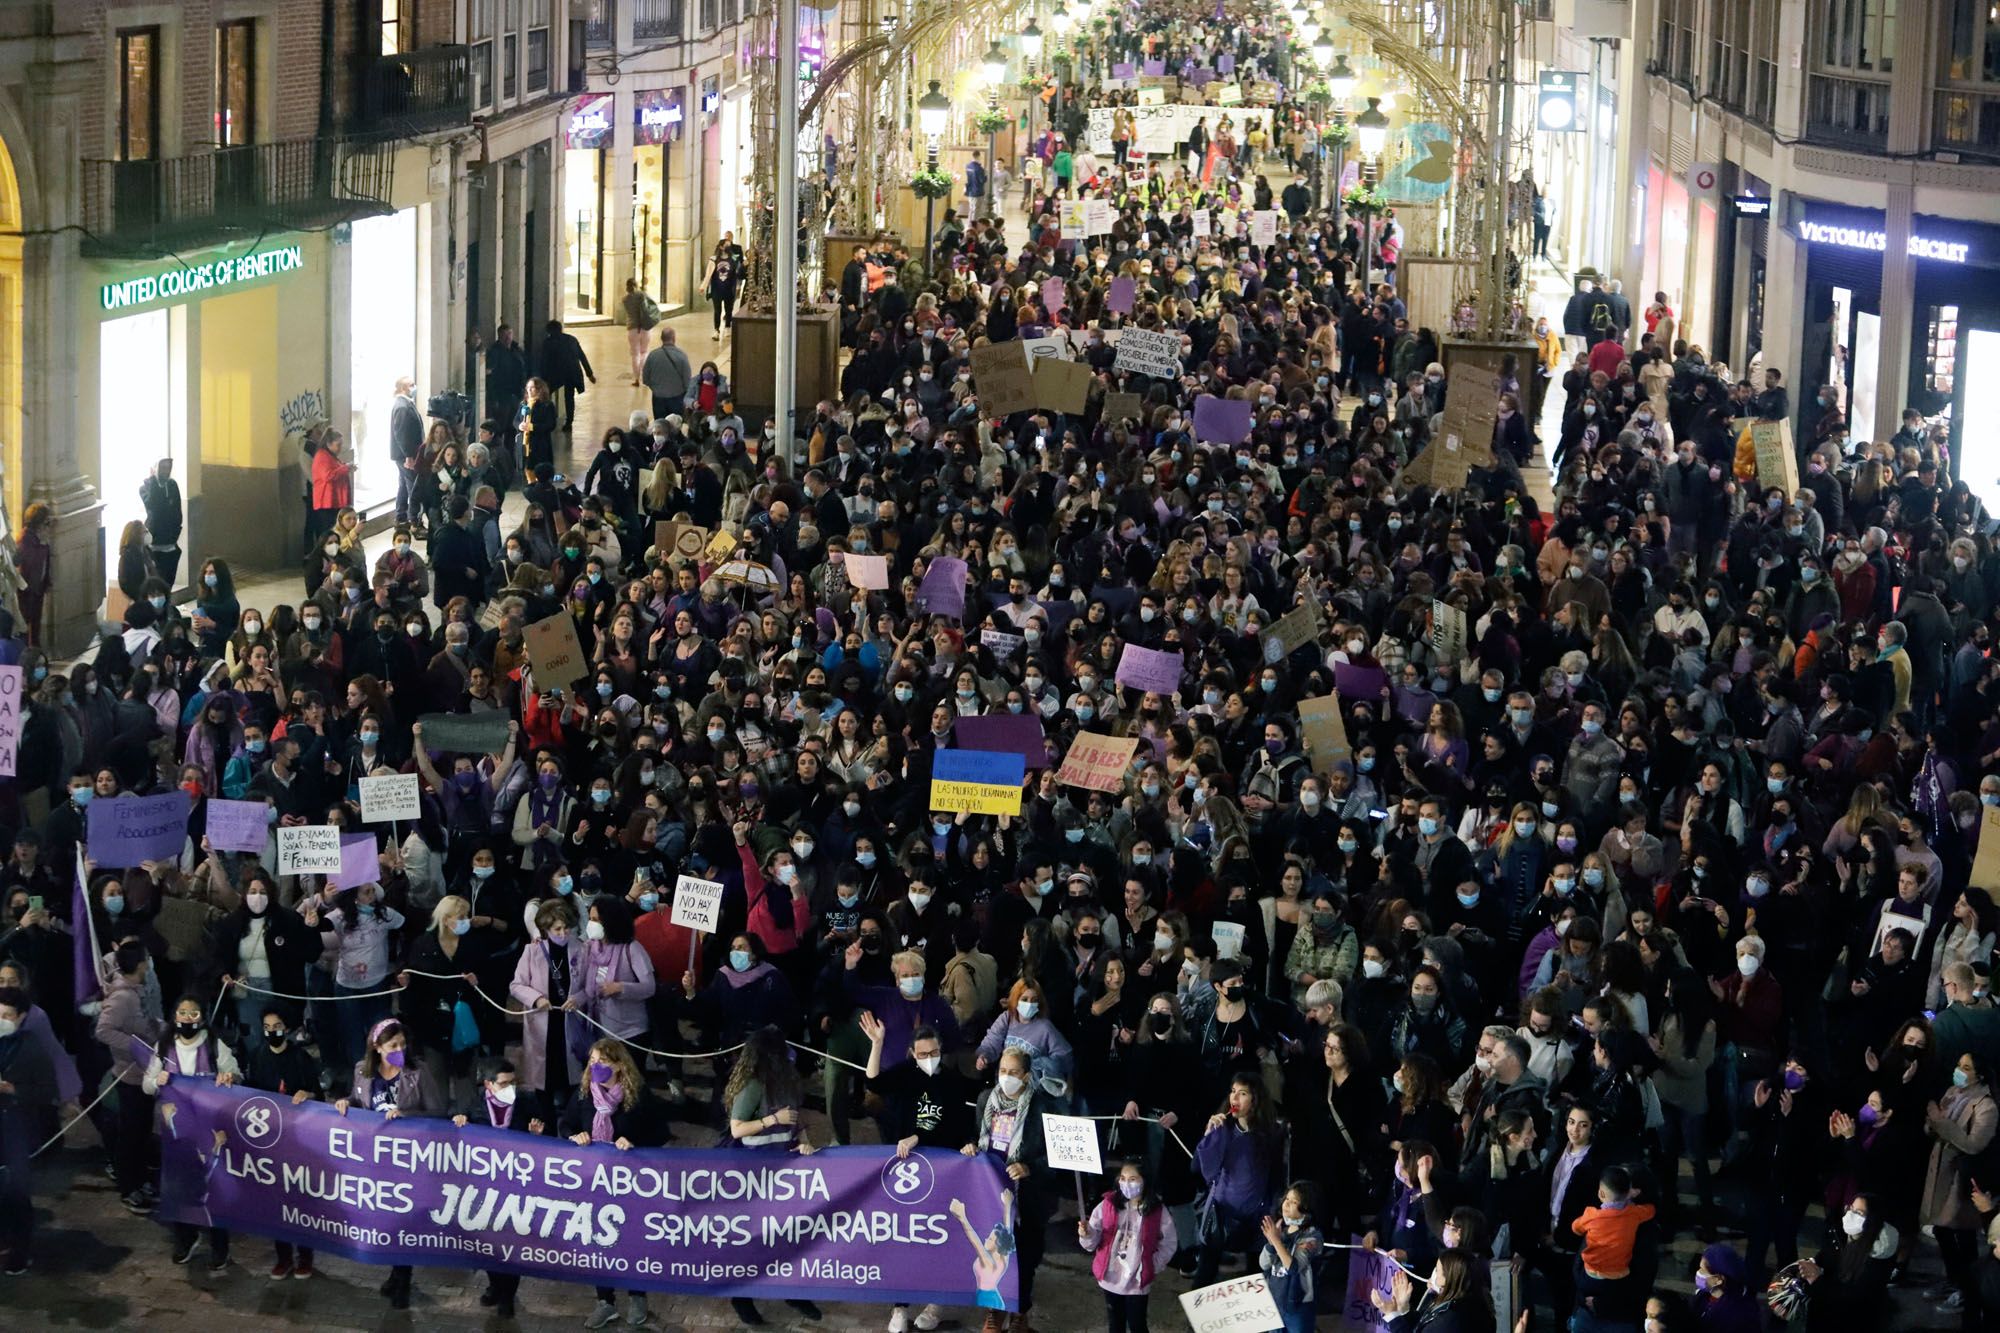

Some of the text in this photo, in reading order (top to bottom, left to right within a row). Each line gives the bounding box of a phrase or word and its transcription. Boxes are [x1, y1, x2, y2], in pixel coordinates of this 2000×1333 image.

[1093, 105, 1174, 120] FEISMOS
[1799, 221, 1968, 262] VICTORIA'S SECRET
[103, 277, 157, 310] UNITED
[158, 263, 213, 298] COLORS
[215, 260, 235, 285] OF
[1122, 327, 1138, 339] HAY
[1140, 331, 1155, 342] QUE
[1118, 347, 1148, 361] POSIBLE
[545, 655, 570, 671] COÑO
[1070, 744, 1127, 768] LIBRES
[936, 783, 951, 794] LAS
[113, 801, 177, 820] FEMINISMO
[935, 798, 945, 807] NO
[948, 798, 955, 808] SE
[283, 829, 336, 841] NO ESTAMOS
[308, 840, 339, 851] TENEMOS
[679, 880, 723, 900] SIN PUTEROS
[679, 895, 713, 911] NO HAY
[682, 910, 710, 926] TRATA
[328, 1127, 830, 1202] EL FEMINISMO ES ABOLICIONISTA
[225, 1148, 949, 1249] LAS MUJERES JUNTAS SOMOS IMPARABLES
[282, 1205, 882, 1285] Movimiento feminista y asociativo de mujeres de Málaga
[1200, 1305, 1277, 1333] GUERRAS
